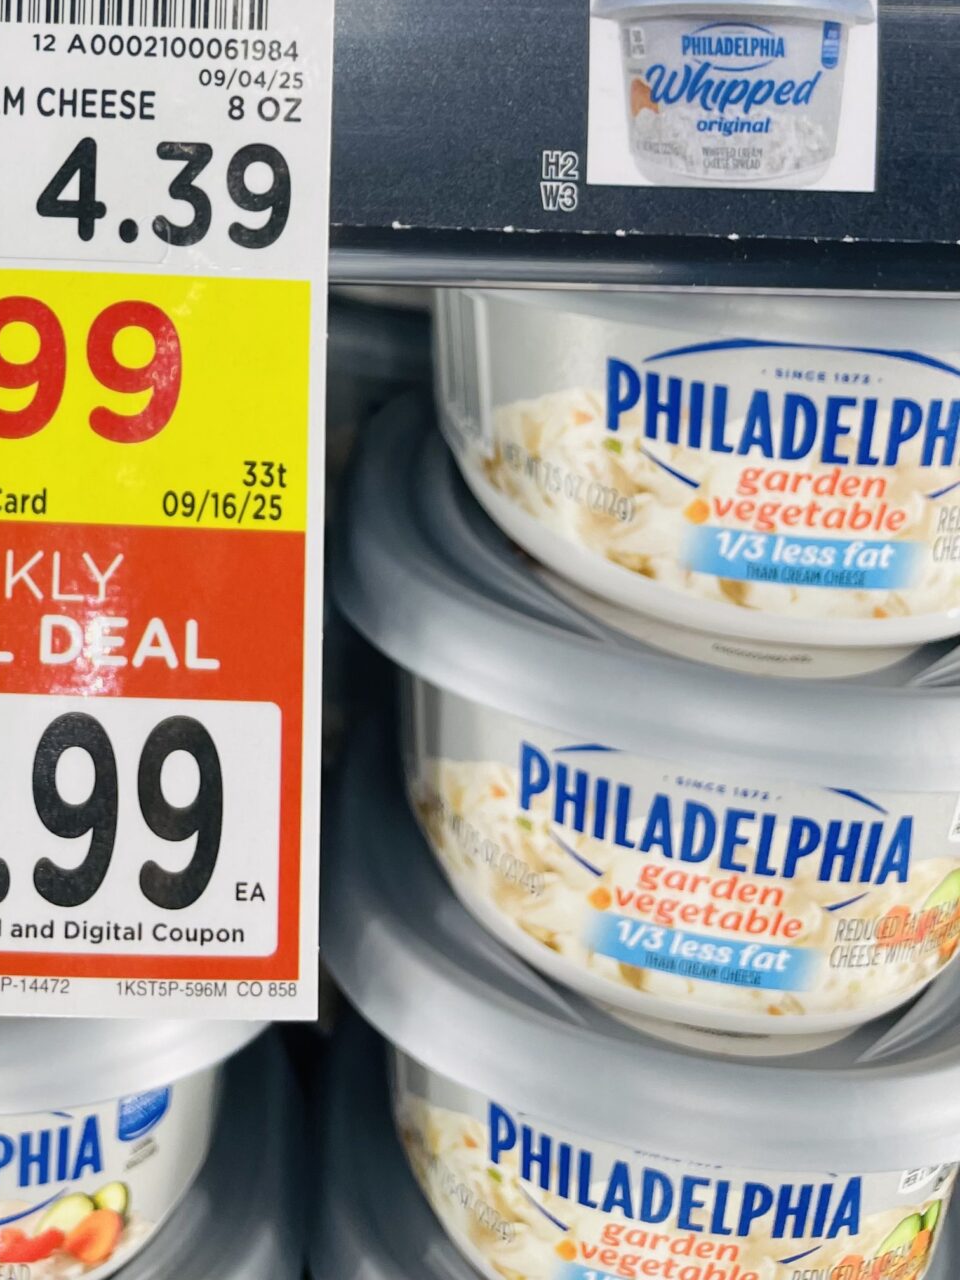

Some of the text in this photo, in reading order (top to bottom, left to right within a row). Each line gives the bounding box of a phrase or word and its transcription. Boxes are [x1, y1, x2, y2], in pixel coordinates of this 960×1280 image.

[33, 34, 299, 62] 12 A0002100061984
[681, 35, 785, 58] PHILADELPHIA
[198, 68, 303, 91] 09/04/25
[645, 63, 822, 114] Whipped
[37, 87, 156, 120] CHEESE
[228, 95, 302, 122] 8 OZ
[697, 116, 771, 135] original
[543, 151, 579, 181] H2
[36, 137, 292, 249] 4.39
[540, 182, 578, 211] W3
[607, 357, 960, 467] PHILADELPH
[243, 460, 287, 489] 33t
[736, 467, 887, 499] garden
[162, 491, 283, 523] 09/16/25
[713, 496, 906, 533] vegetable
[716, 530, 896, 569] 1/3 less fat
[39, 613, 221, 671] DEAL
[519, 741, 914, 885] PHILADELPHIA
[235, 882, 266, 903] EA
[639, 864, 785, 907] garden
[615, 885, 804, 939] vegetable
[10, 920, 55, 940] and
[64, 921, 143, 945] Digital
[152, 923, 245, 946] Coupon
[617, 920, 792, 972] 1/3 less fat
[1, 977, 70, 994] P-14472
[116, 981, 298, 998] 1KST5P-596M CO 858
[487, 1100, 862, 1240] PHILADELPHIA
[600, 1223, 739, 1261] garden
